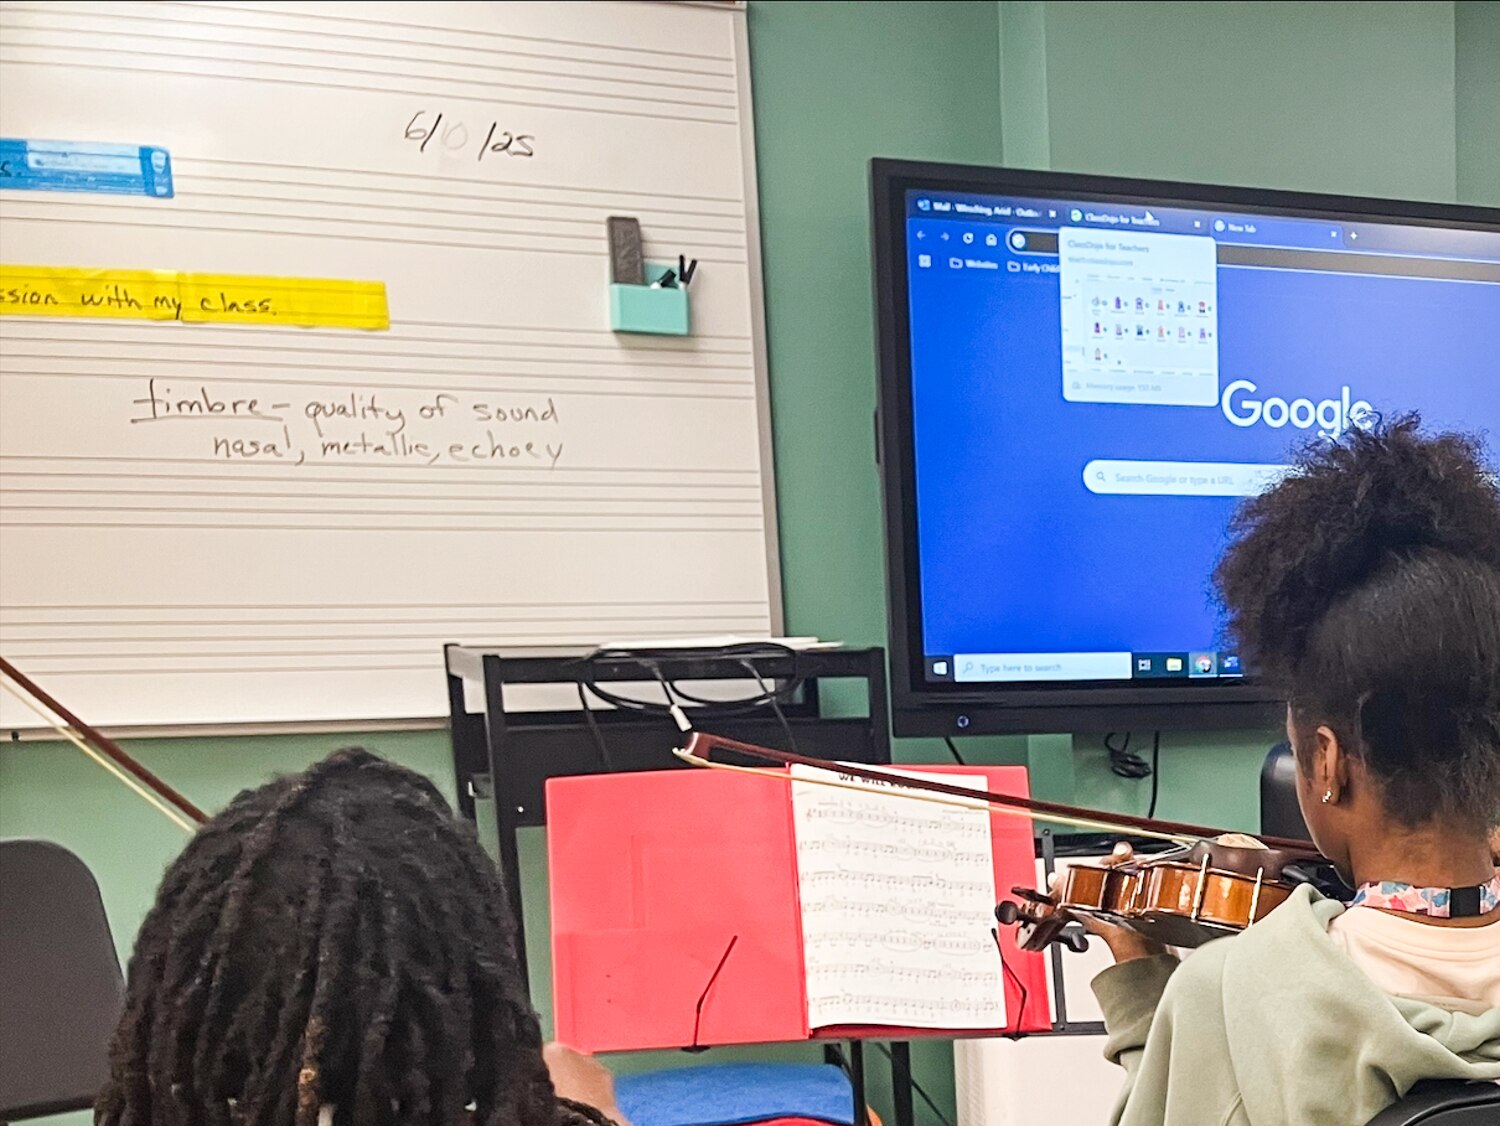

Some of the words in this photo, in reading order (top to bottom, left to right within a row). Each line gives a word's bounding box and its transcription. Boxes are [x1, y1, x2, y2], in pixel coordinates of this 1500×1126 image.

[81, 284, 142, 310] with
[154, 294, 182, 320] my
[305, 392, 405, 436] quality
[419, 394, 459, 419] of
[473, 398, 559, 424] sound
[1221, 379, 1373, 441] Google
[449, 429, 563, 471] echoey
[1115, 473, 1144, 482] Search
[1146, 474, 1176, 485] Google
[981, 664, 1000, 675] Type
[1003, 663, 1021, 672] here
[1024, 664, 1032, 672] to
[1035, 663, 1062, 672] search
